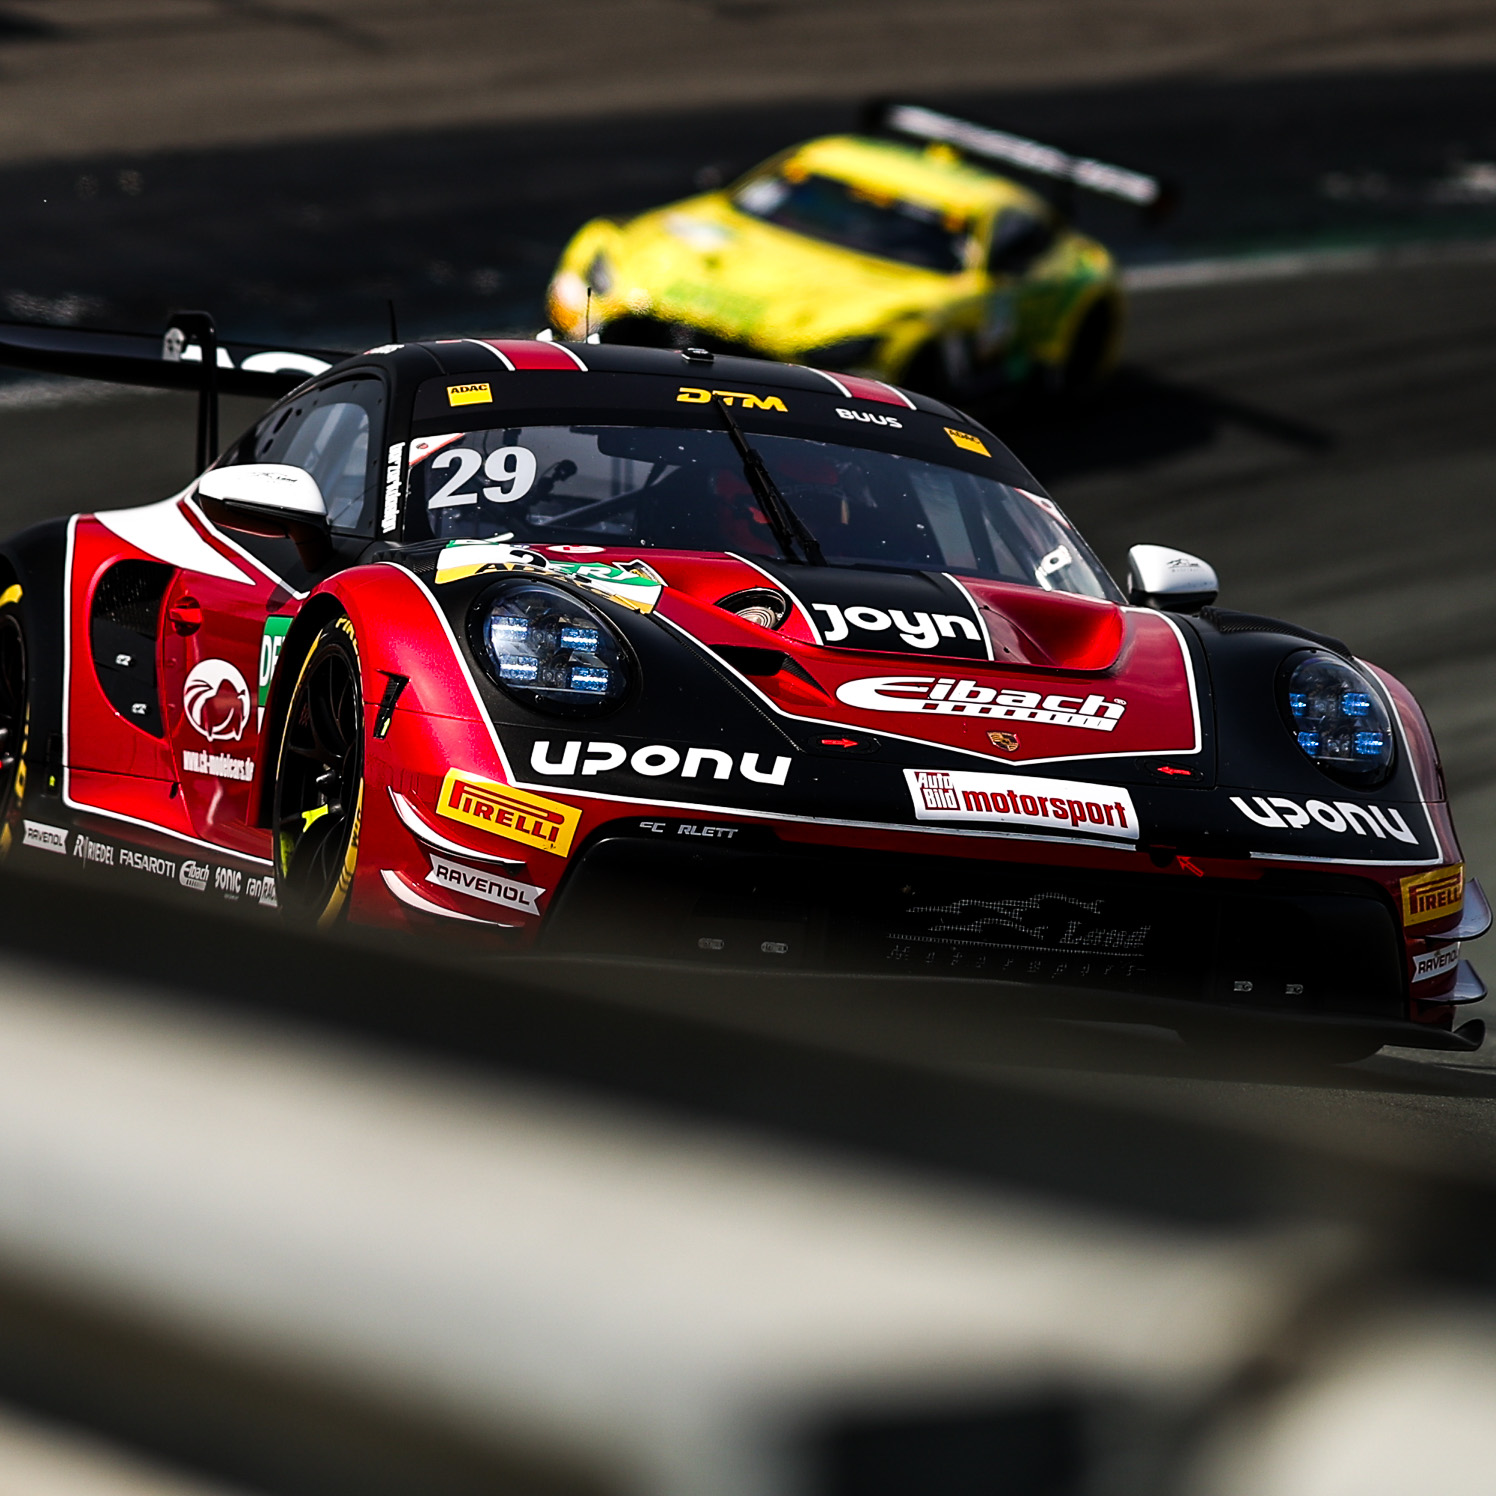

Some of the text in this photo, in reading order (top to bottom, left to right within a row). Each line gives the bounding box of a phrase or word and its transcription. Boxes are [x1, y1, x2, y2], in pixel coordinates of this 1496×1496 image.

[450, 384, 488, 394] ADAC
[676, 387, 787, 412] DTM
[835, 408, 903, 429] BUUS
[427, 446, 537, 510] 29
[835, 676, 1125, 721] Eibach
[918, 773, 954, 789] Auto
[448, 779, 566, 842] PIRELLI
[924, 789, 1128, 829] Bild motorsport
[27, 827, 63, 846] RAVENOL
[87, 840, 114, 866] RIEDEL
[119, 848, 176, 879] FASAROTI
[436, 864, 532, 905] RAVENOL
